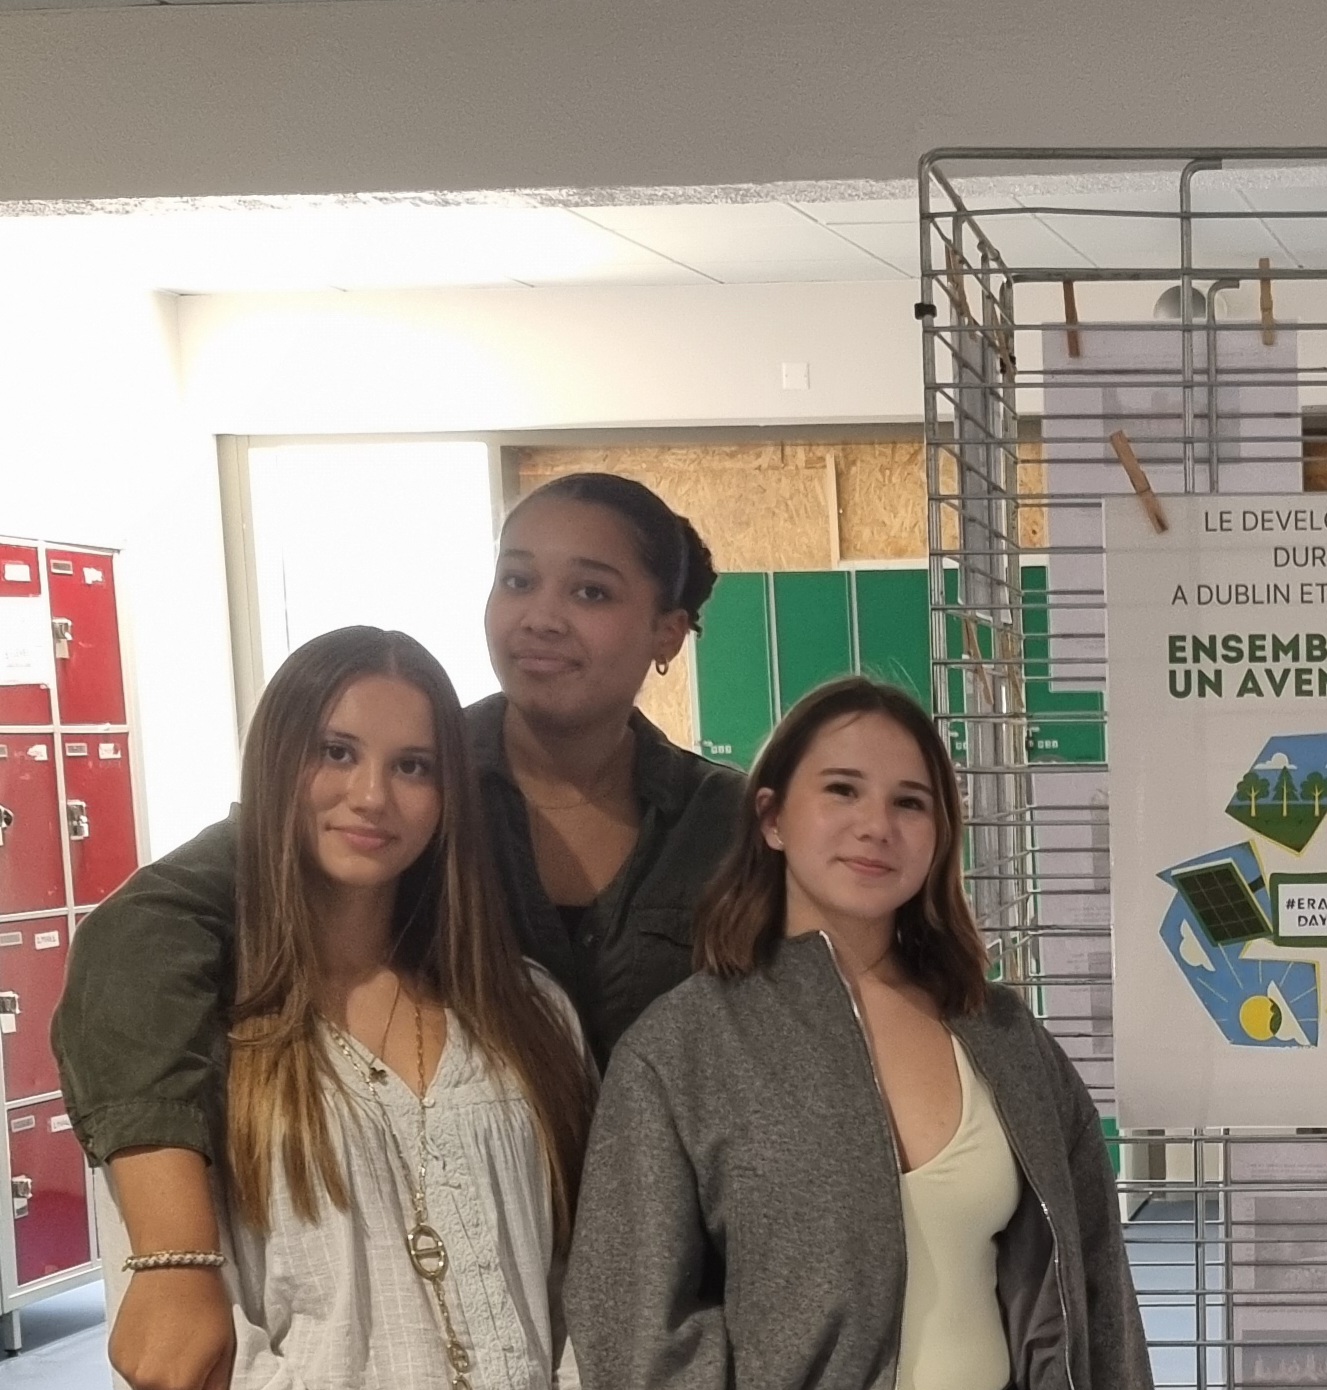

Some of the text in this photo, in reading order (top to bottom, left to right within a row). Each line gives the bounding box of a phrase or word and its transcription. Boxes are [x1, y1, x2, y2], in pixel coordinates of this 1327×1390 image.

[1203, 510, 1233, 532] LE
[1170, 584, 1189, 606] A
[1196, 583, 1291, 606] DUBLIN
[1168, 668, 1223, 699] UN
